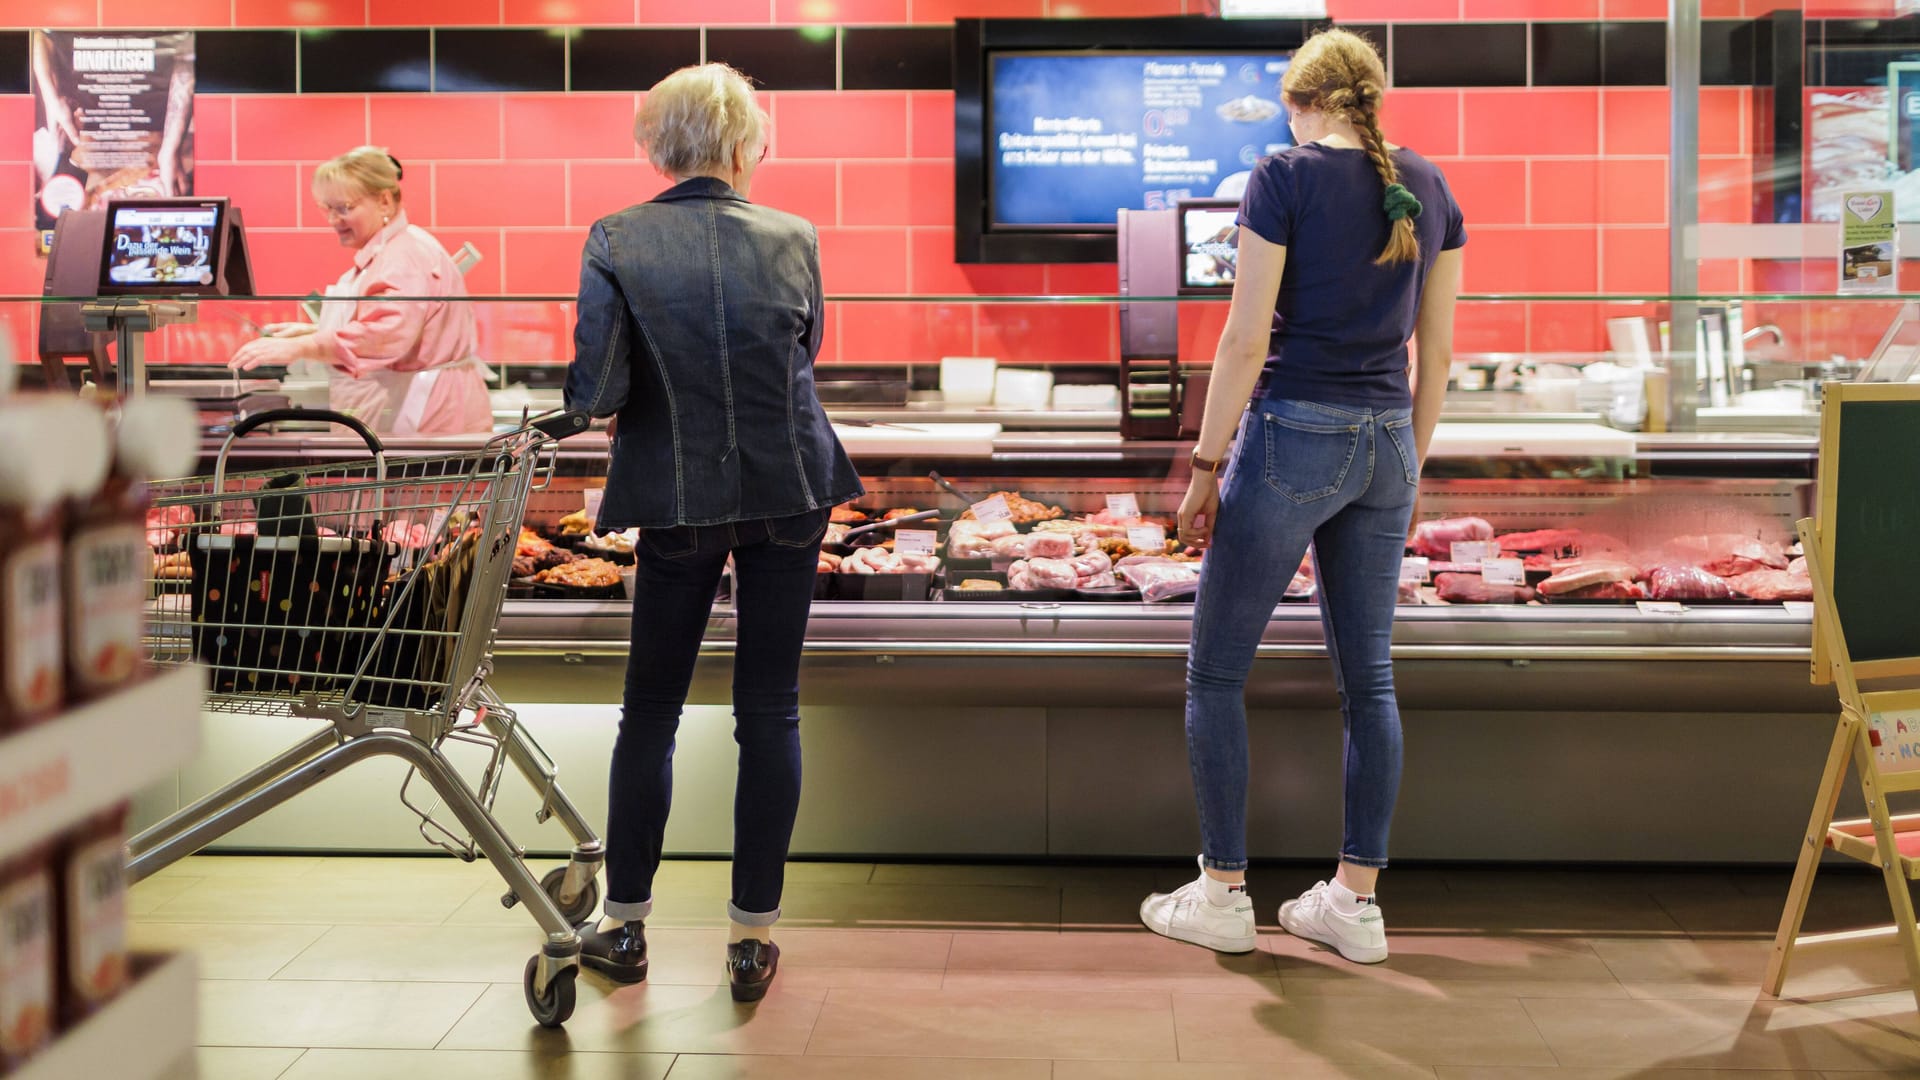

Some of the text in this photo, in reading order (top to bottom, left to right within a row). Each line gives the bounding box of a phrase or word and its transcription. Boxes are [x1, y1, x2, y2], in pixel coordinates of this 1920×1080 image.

[73, 50, 154, 71] RINDFLEISCH
[117, 233, 158, 250] Dazu der
[128, 245, 191, 256] passende Wein
